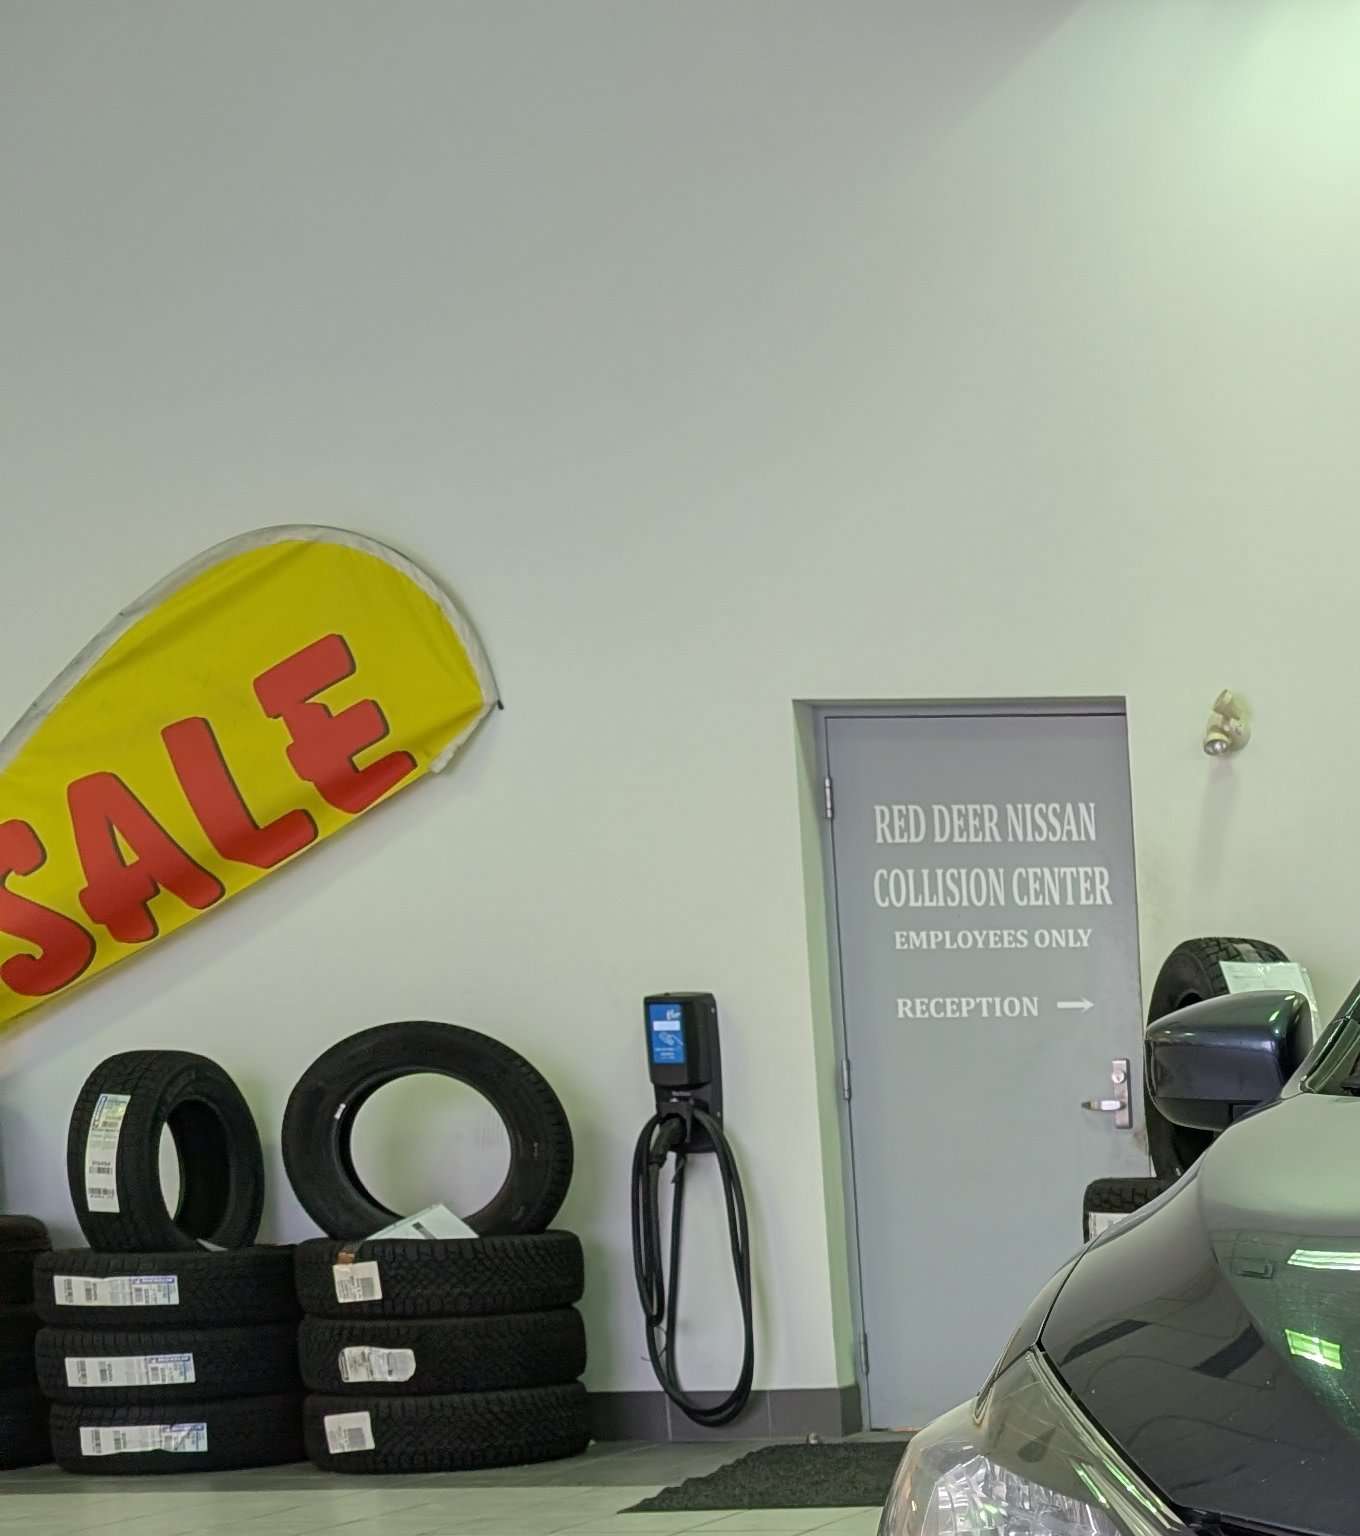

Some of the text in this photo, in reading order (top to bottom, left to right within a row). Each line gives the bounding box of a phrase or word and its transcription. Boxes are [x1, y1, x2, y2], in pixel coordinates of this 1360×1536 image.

[0, 633, 418, 997] SALE
[874, 802, 1097, 844] RED DEER NISSAN
[873, 866, 1113, 907] COLLISION CENTER
[894, 928, 1093, 950] EMPLOYEES ONLY
[896, 996, 1039, 1018] RECEPTION
